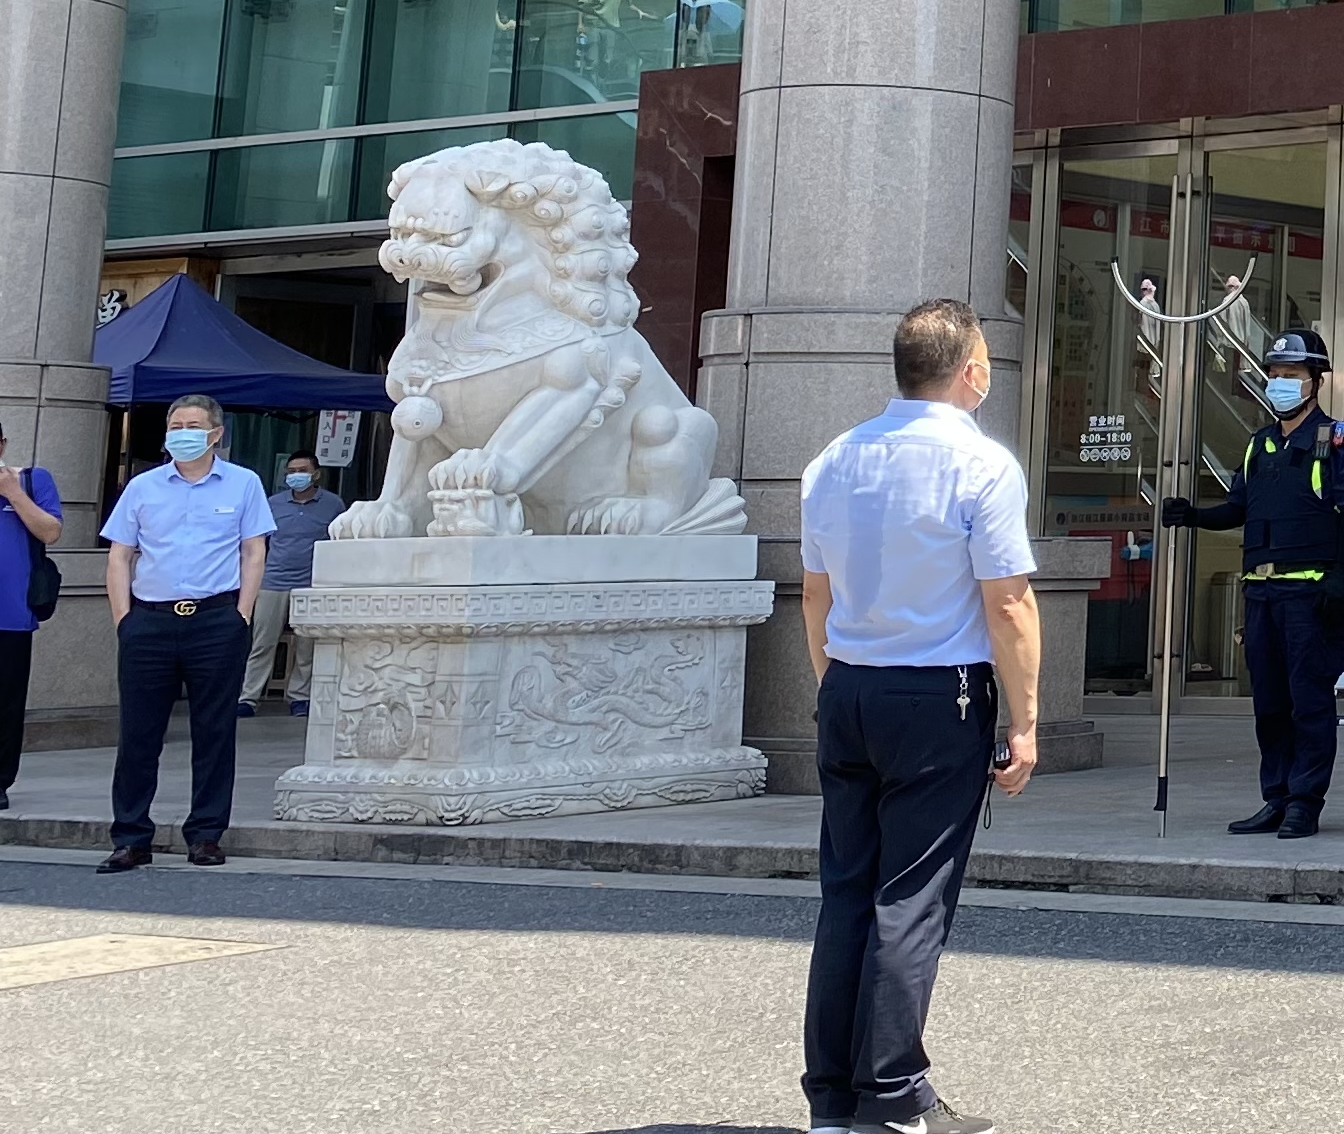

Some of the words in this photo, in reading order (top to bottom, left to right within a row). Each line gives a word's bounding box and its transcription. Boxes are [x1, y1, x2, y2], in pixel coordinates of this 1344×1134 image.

[1089, 415, 1125, 426] 营业时间
[1080, 432, 1132, 444] 8:00-18:00
